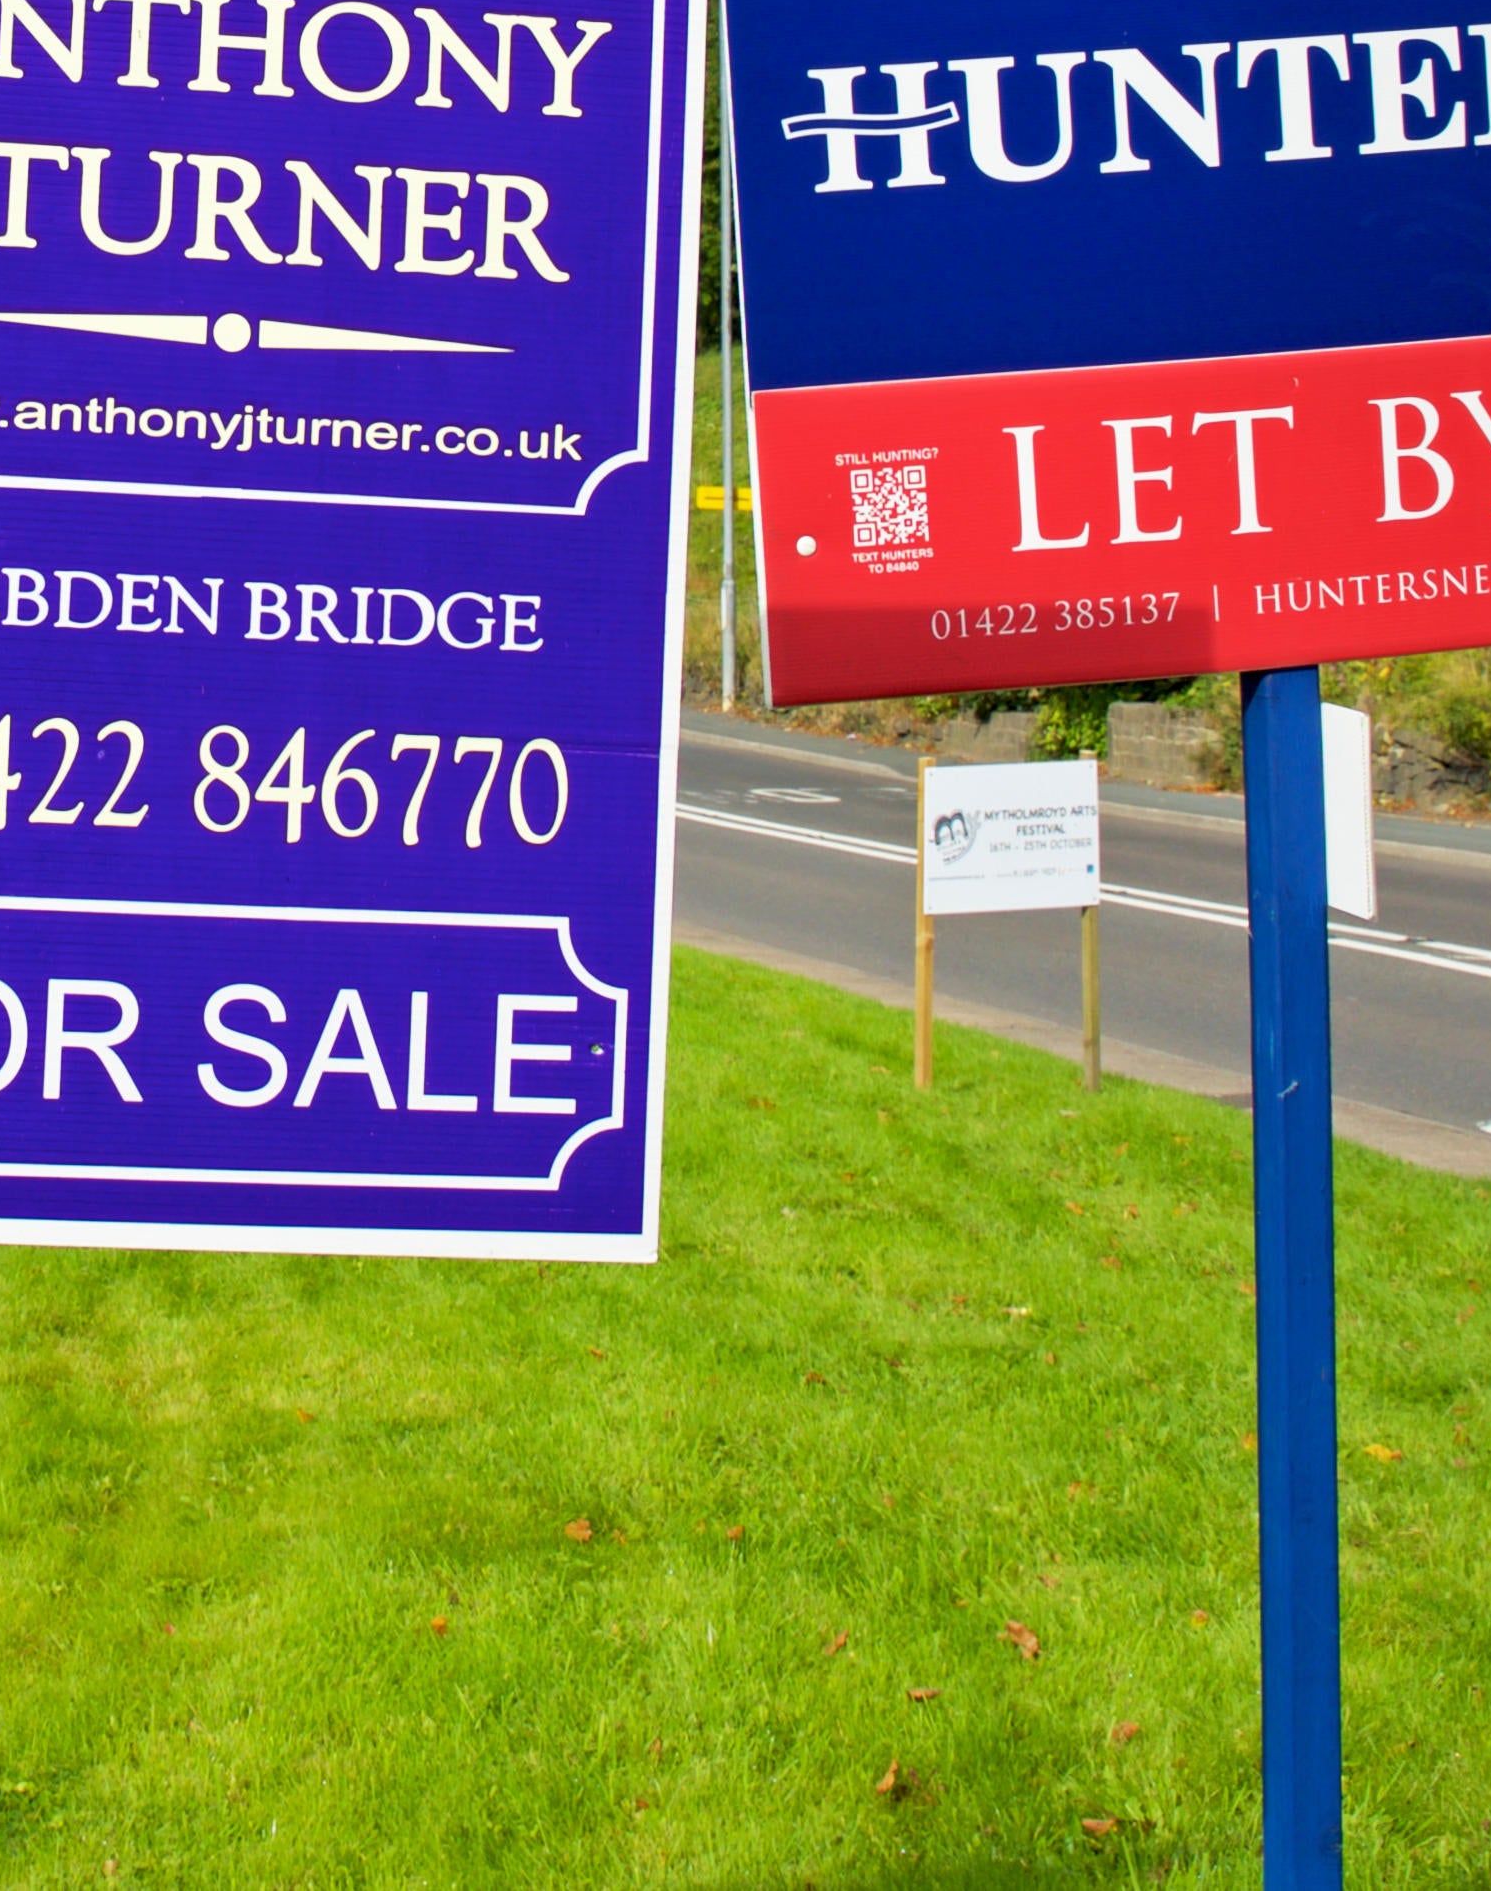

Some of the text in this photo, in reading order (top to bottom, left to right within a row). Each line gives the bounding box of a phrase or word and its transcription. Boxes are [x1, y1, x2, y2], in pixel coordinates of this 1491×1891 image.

[835, 447, 939, 467] STILL HUNTING?
[1002, 406, 1294, 552] LET
[852, 547, 934, 563] TEXT HUNTERS
[868, 564, 884, 574] TO
[244, 582, 544, 652] BRIDGE
[931, 592, 1180, 641] 01422 385137
[194, 725, 569, 848] 846770
[984, 805, 1098, 821] MYTHOLMROYD ARTS
[1016, 824, 1066, 836] FESTIVAL
[1050, 837, 1093, 850] OCTOBER
[198, 982, 579, 1115] SALE
